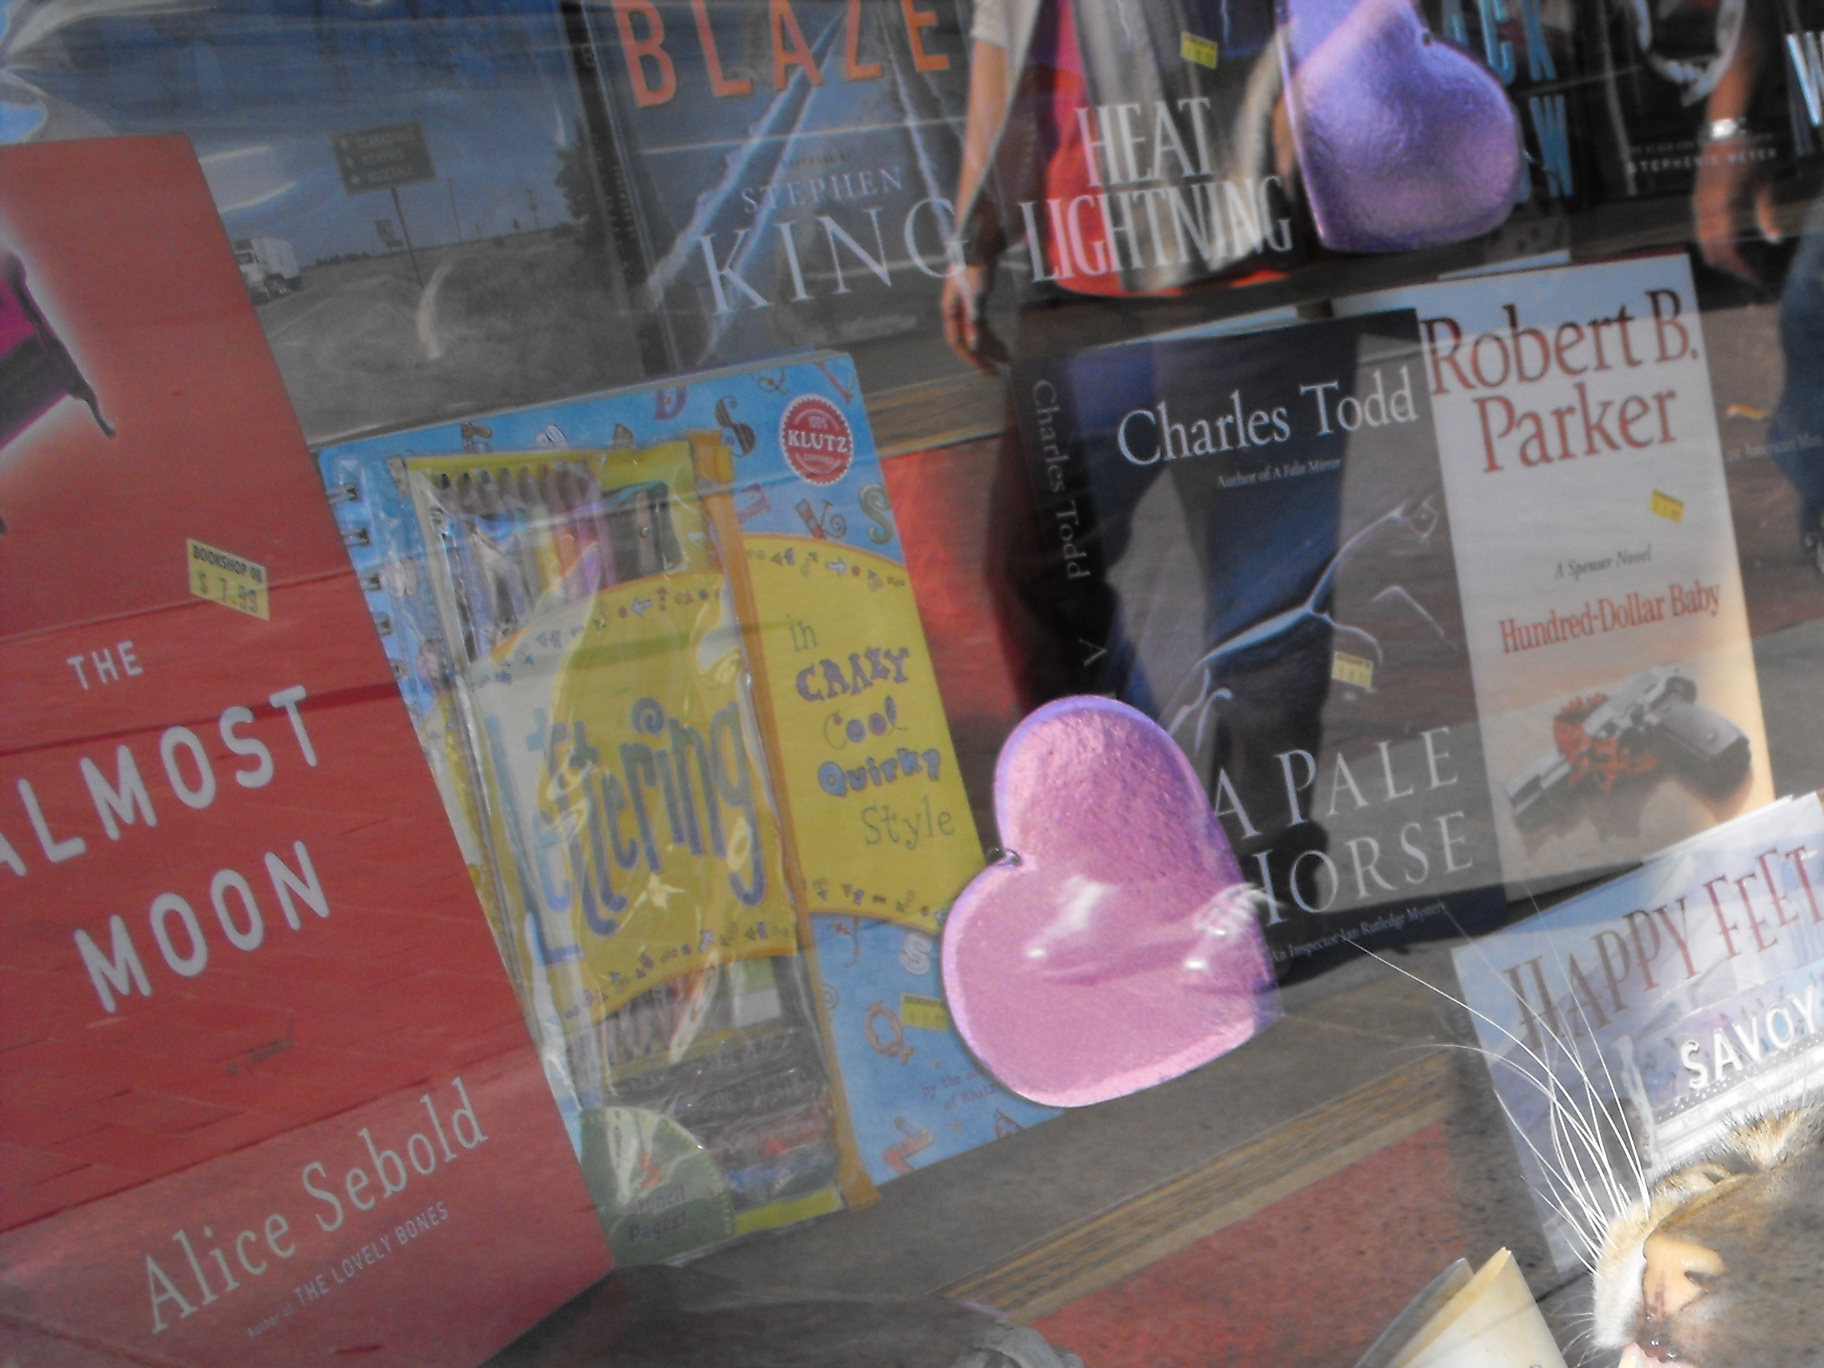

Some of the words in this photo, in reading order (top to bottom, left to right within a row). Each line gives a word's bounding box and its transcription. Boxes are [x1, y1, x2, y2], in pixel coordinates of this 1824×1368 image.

[613, 0, 950, 108] BLAZE
[741, 166, 903, 214] STEPHEN
[1075, 97, 1215, 188] HEAT
[701, 198, 968, 316] KING
[1018, 175, 1294, 283] LIGHTNING
[1420, 303, 1636, 394] Robert
[1645, 289, 1698, 364] B.
[788, 429, 848, 453] KLUTZ
[1117, 389, 1291, 467] Charles
[1300, 367, 1419, 437] Todd
[1473, 387, 1677, 474] Parker
[1032, 379, 1069, 494] Charles
[1055, 499, 1090, 580] Todd
[1616, 544, 1653, 567] Novel
[1669, 579, 1720, 617] Baby
[67, 642, 143, 689] THE
[796, 647, 910, 701] CRAZY
[861, 795, 955, 850] Style
[1215, 767, 1261, 840] A
[1274, 726, 1458, 826] PALE
[74, 840, 330, 1013] MOON
[1503, 893, 1701, 1050] HAPPY
[1681, 991, 1820, 1092] SAVOY
[145, 1214, 297, 1334] Alice
[302, 1076, 488, 1232] Sebold
[294, 1274, 330, 1307] THE
[331, 1233, 393, 1284] LOVELY
[394, 1202, 449, 1246] BONES
